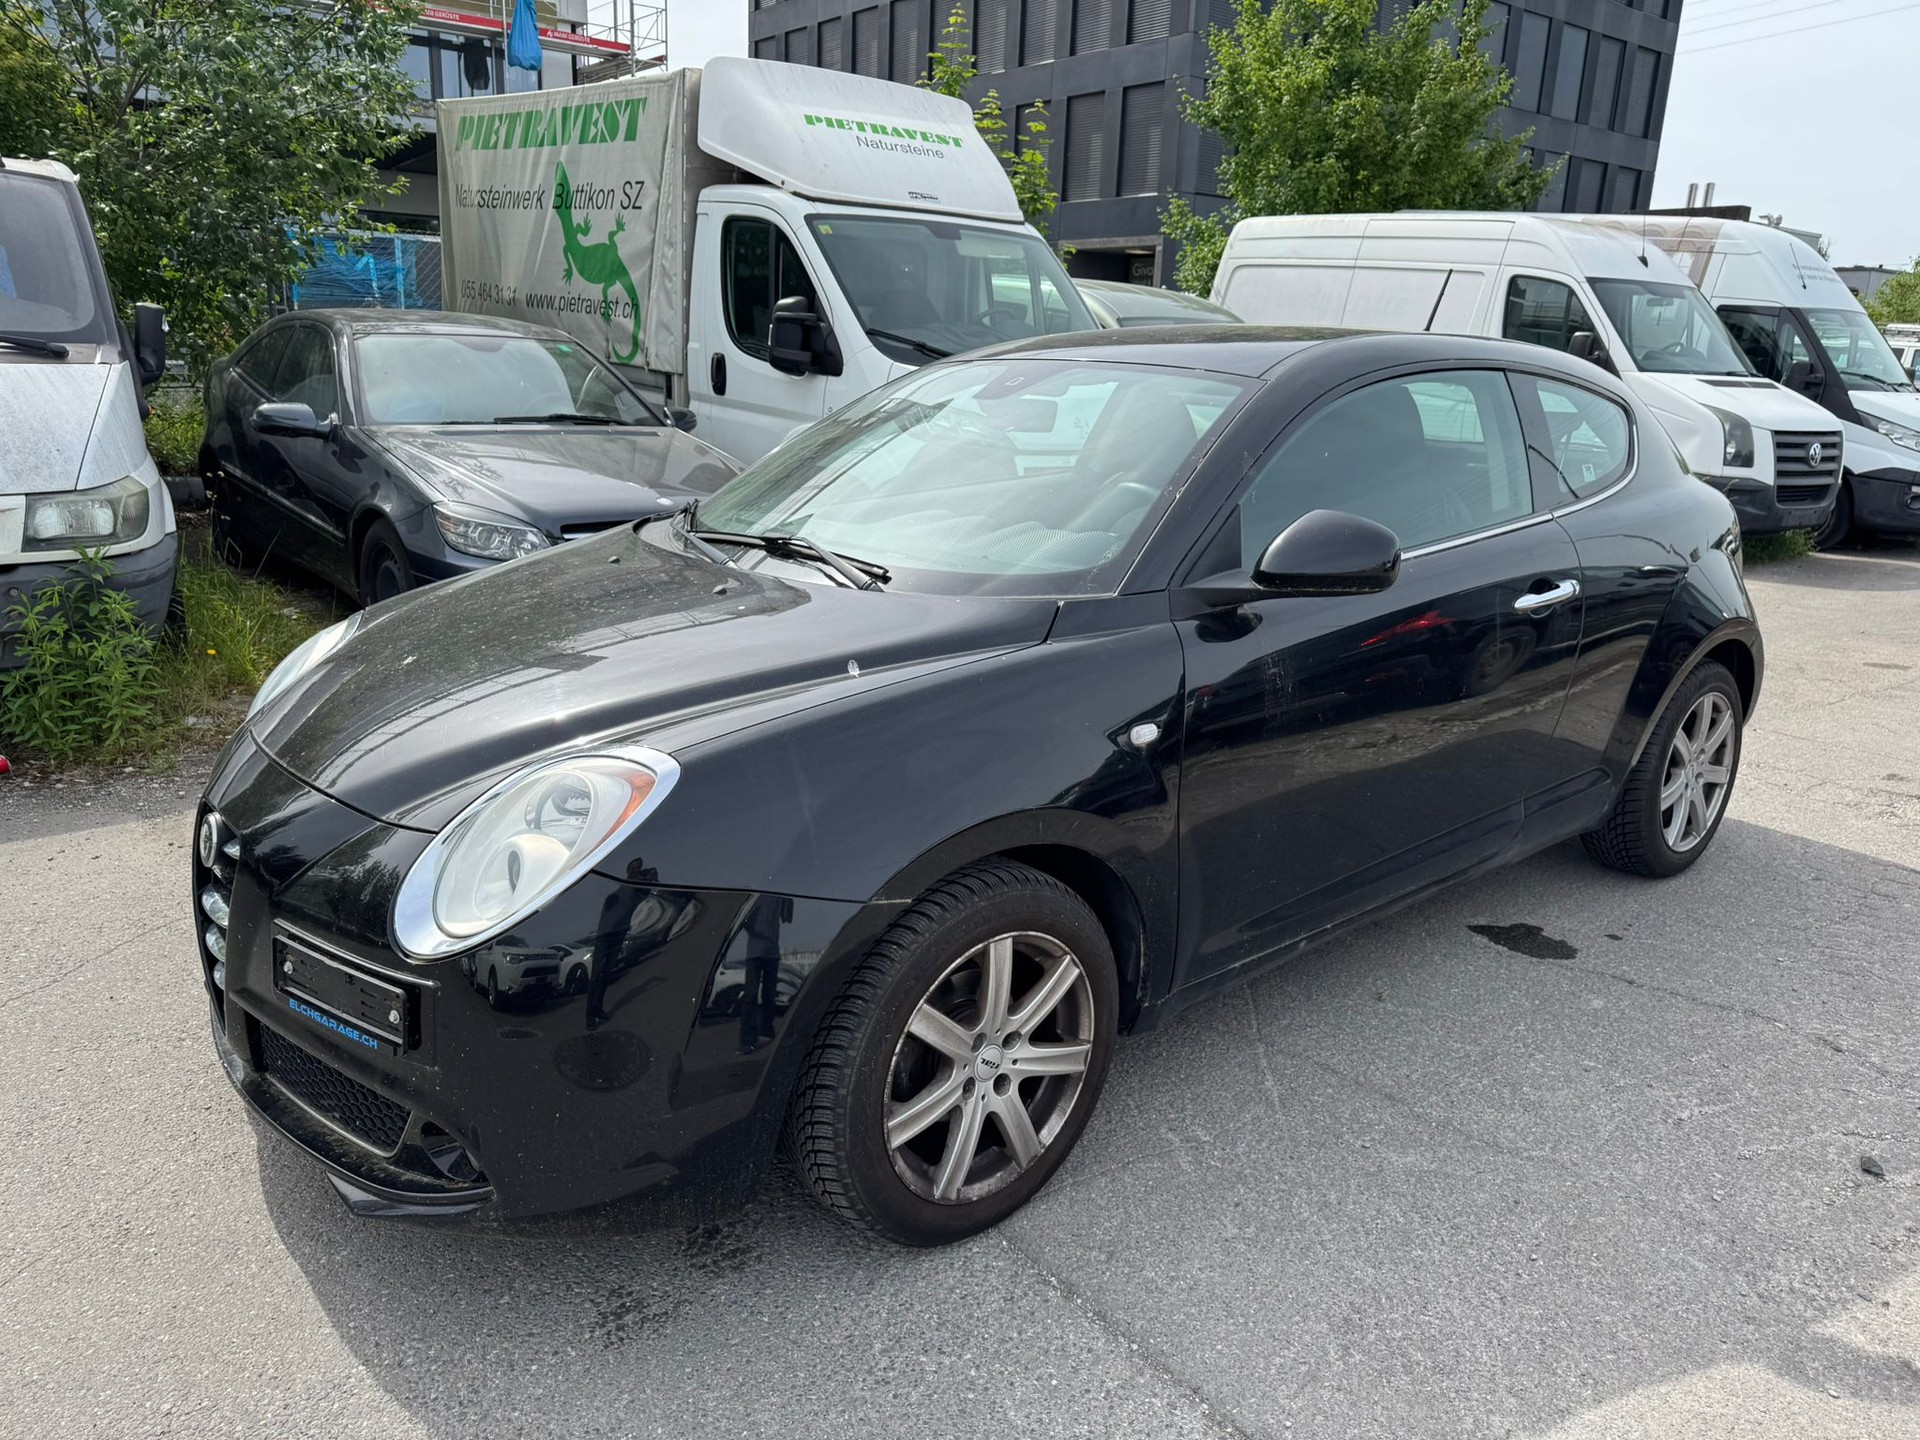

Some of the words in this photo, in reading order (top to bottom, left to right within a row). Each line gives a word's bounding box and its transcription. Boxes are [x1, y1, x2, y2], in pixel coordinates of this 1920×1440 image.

[455, 97, 648, 151] PIETRAVEST
[803, 113, 963, 148] PIETRAVEST
[855, 135, 945, 159] Natursteine
[455, 183, 545, 210] Natursteinwerk
[552, 182, 615, 210] Buttikon
[620, 180, 645, 210] SZ
[461, 279, 476, 300] 055
[477, 282, 492, 302] 464
[494, 284, 504, 304] 31
[506, 286, 517, 307] 31
[525, 291, 639, 320] www.pietravest.ch
[288, 998, 379, 1050] ELCHGARAGE.CH
